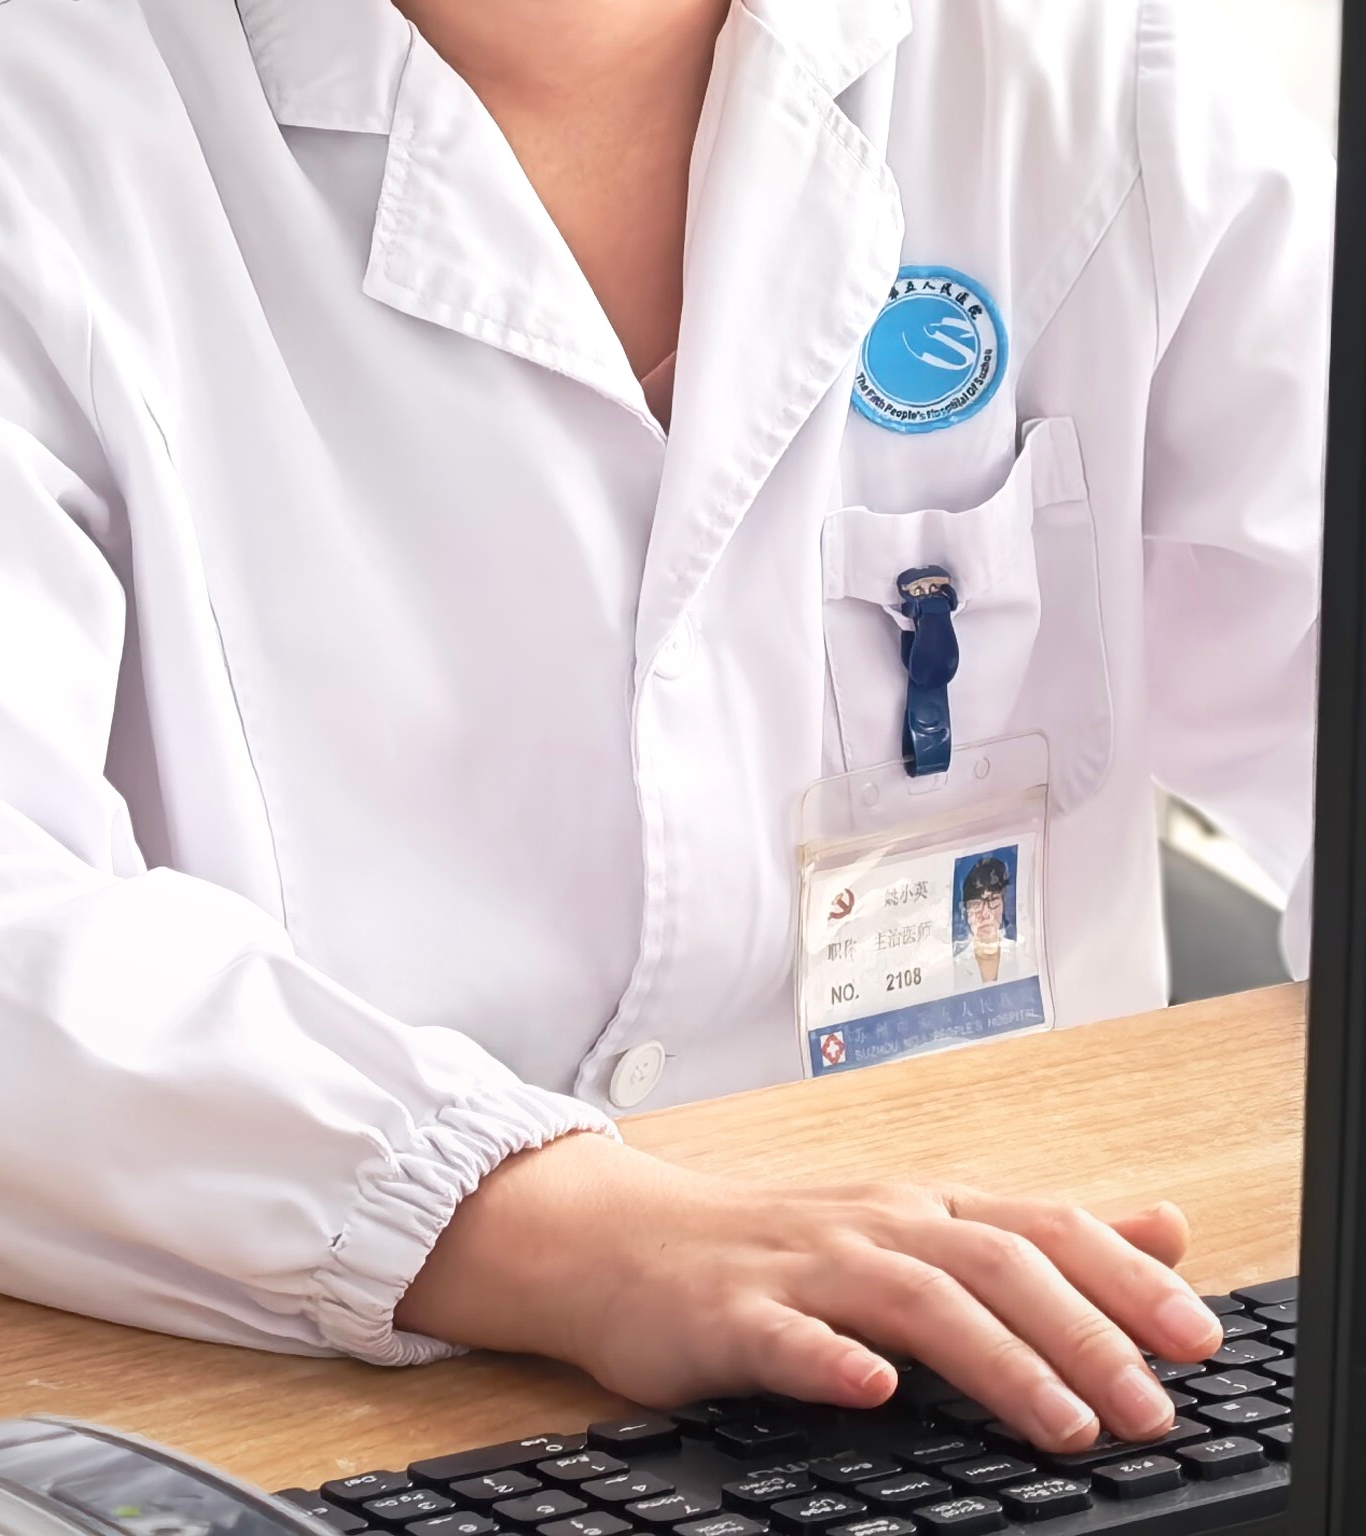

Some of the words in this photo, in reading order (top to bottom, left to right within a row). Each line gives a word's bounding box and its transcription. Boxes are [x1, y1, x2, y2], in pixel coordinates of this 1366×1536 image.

[874, 921, 933, 952] 主治医师
[830, 982, 860, 1005] NO.
[885, 967, 923, 992] 2108
